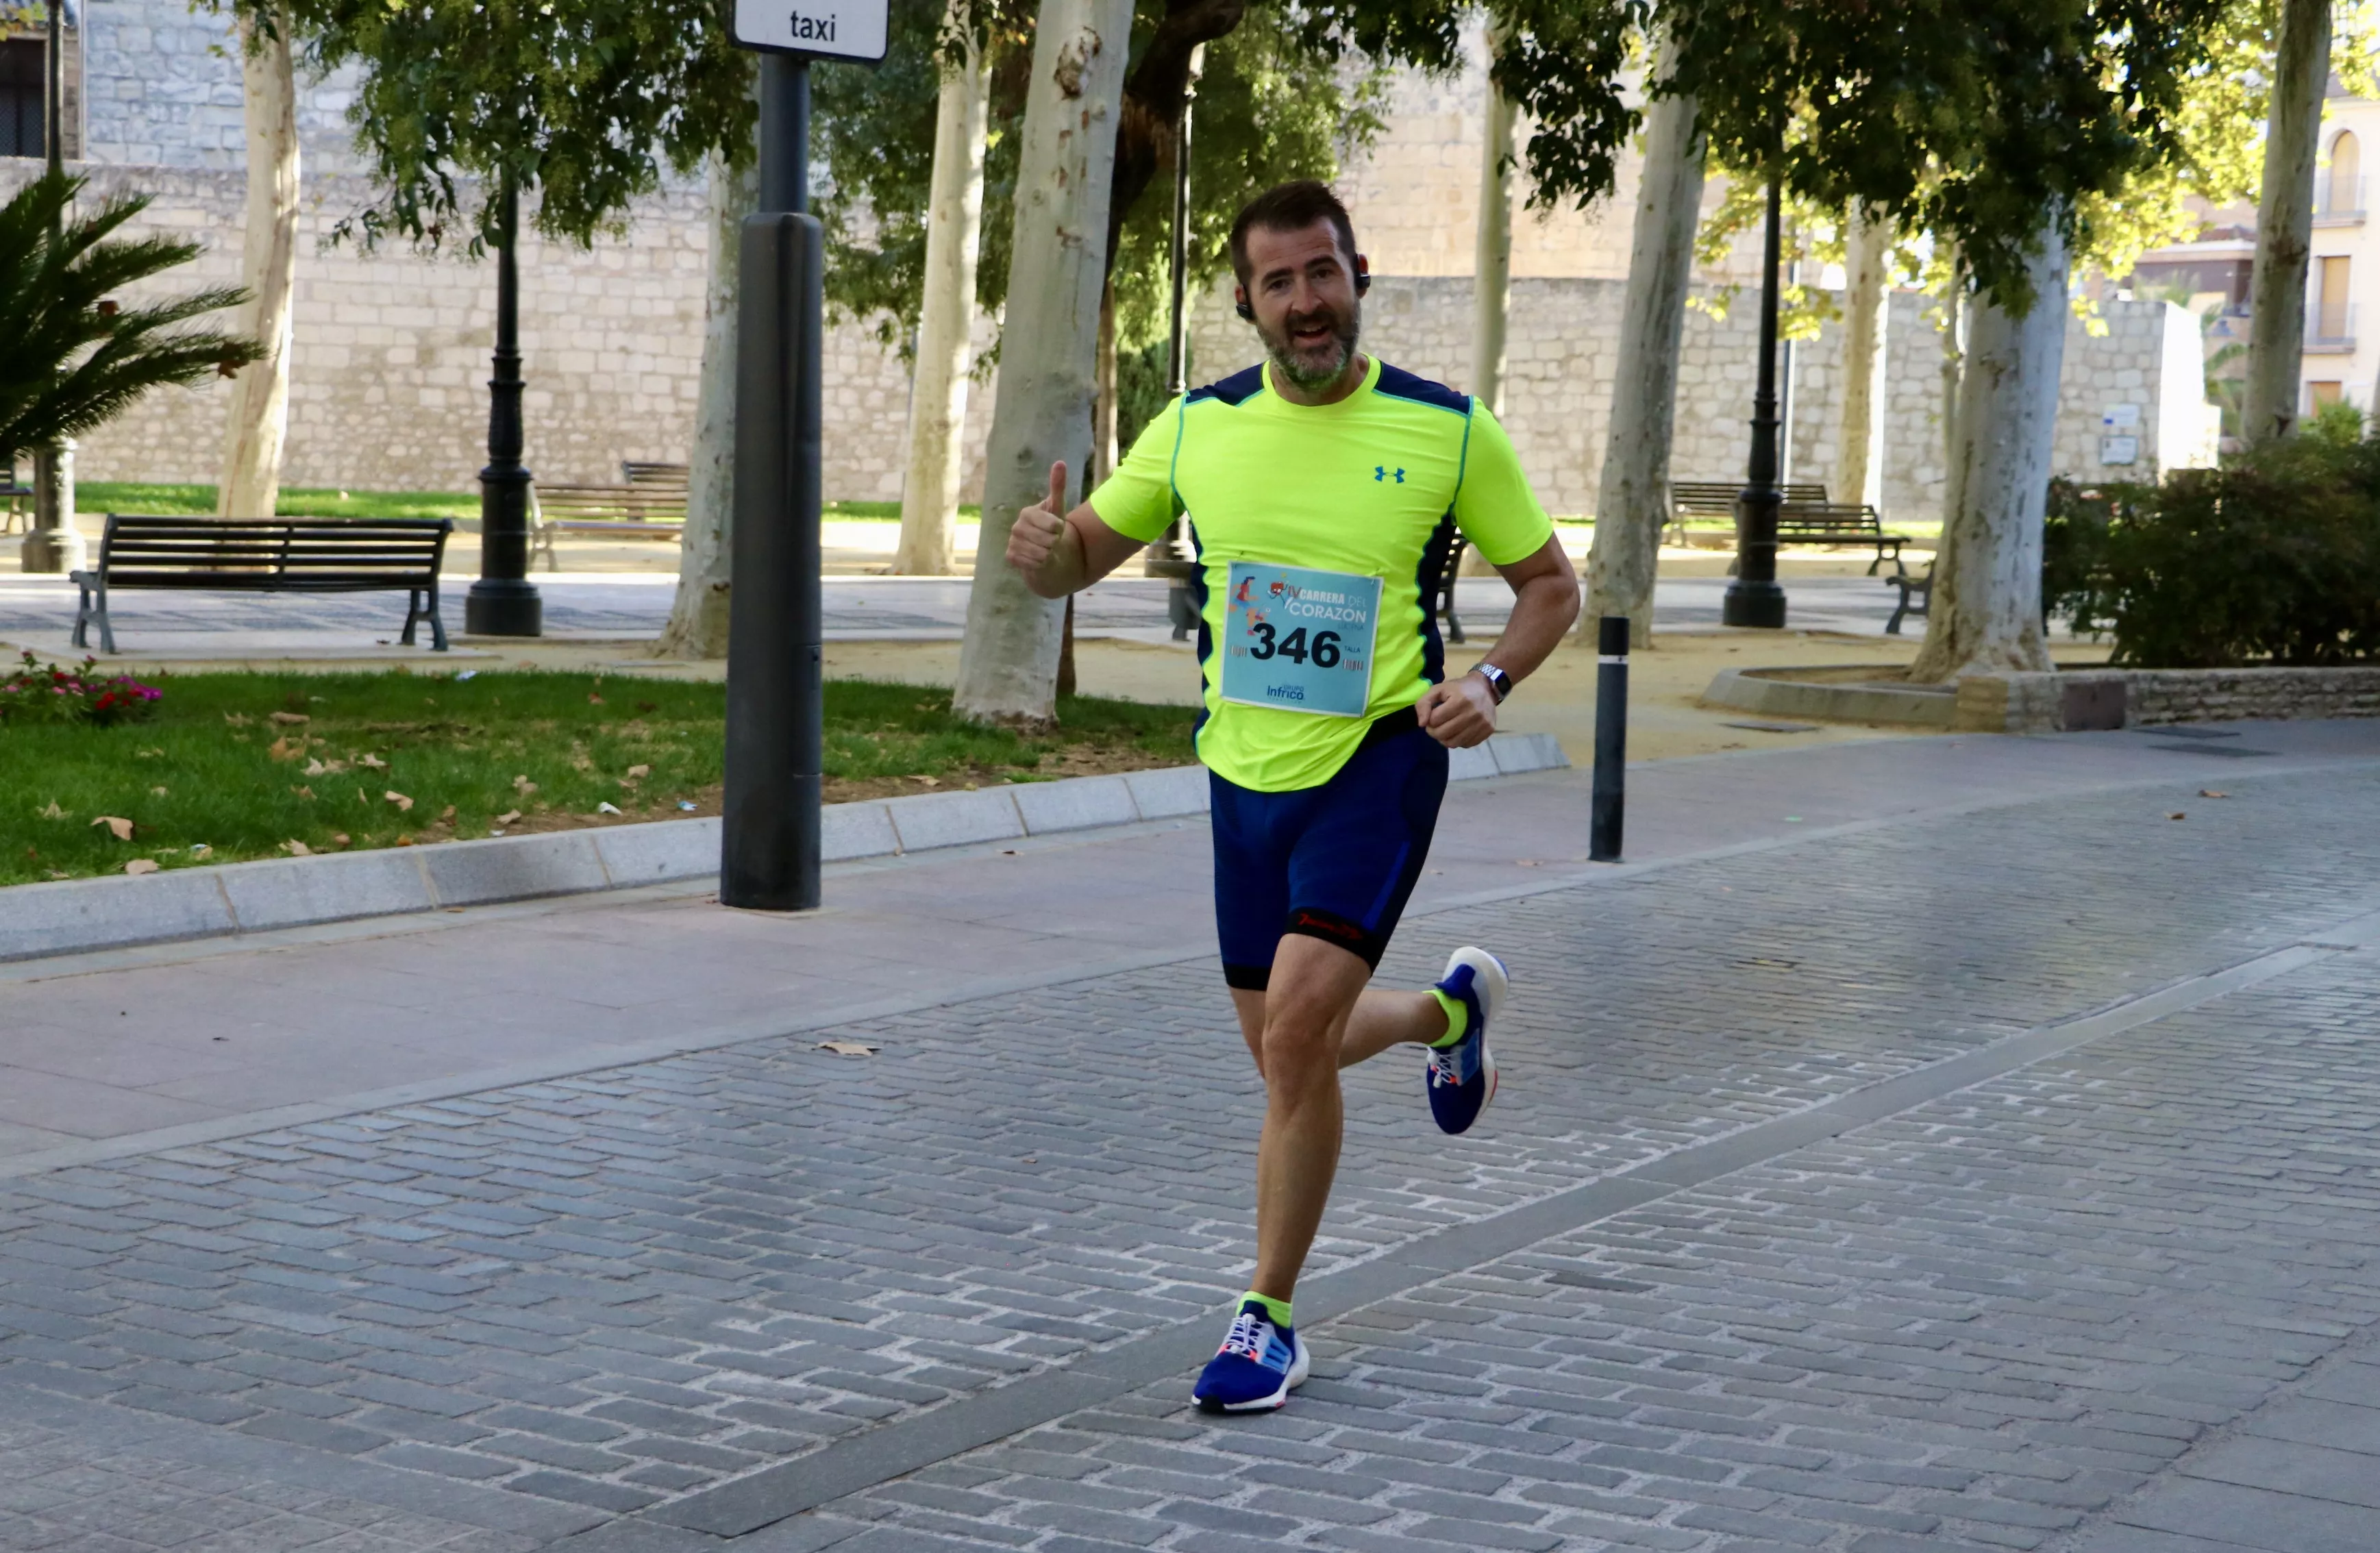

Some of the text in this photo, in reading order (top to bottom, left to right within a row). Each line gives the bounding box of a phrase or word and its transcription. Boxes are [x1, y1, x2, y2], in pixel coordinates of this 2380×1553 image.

[791, 10, 836, 42] taxi
[1288, 585, 1366, 608] IV CARRERA DEL
[1289, 602, 1367, 623] CORAZÓN
[1250, 623, 1341, 668] 346
[1267, 685, 1304, 700] Infrico
